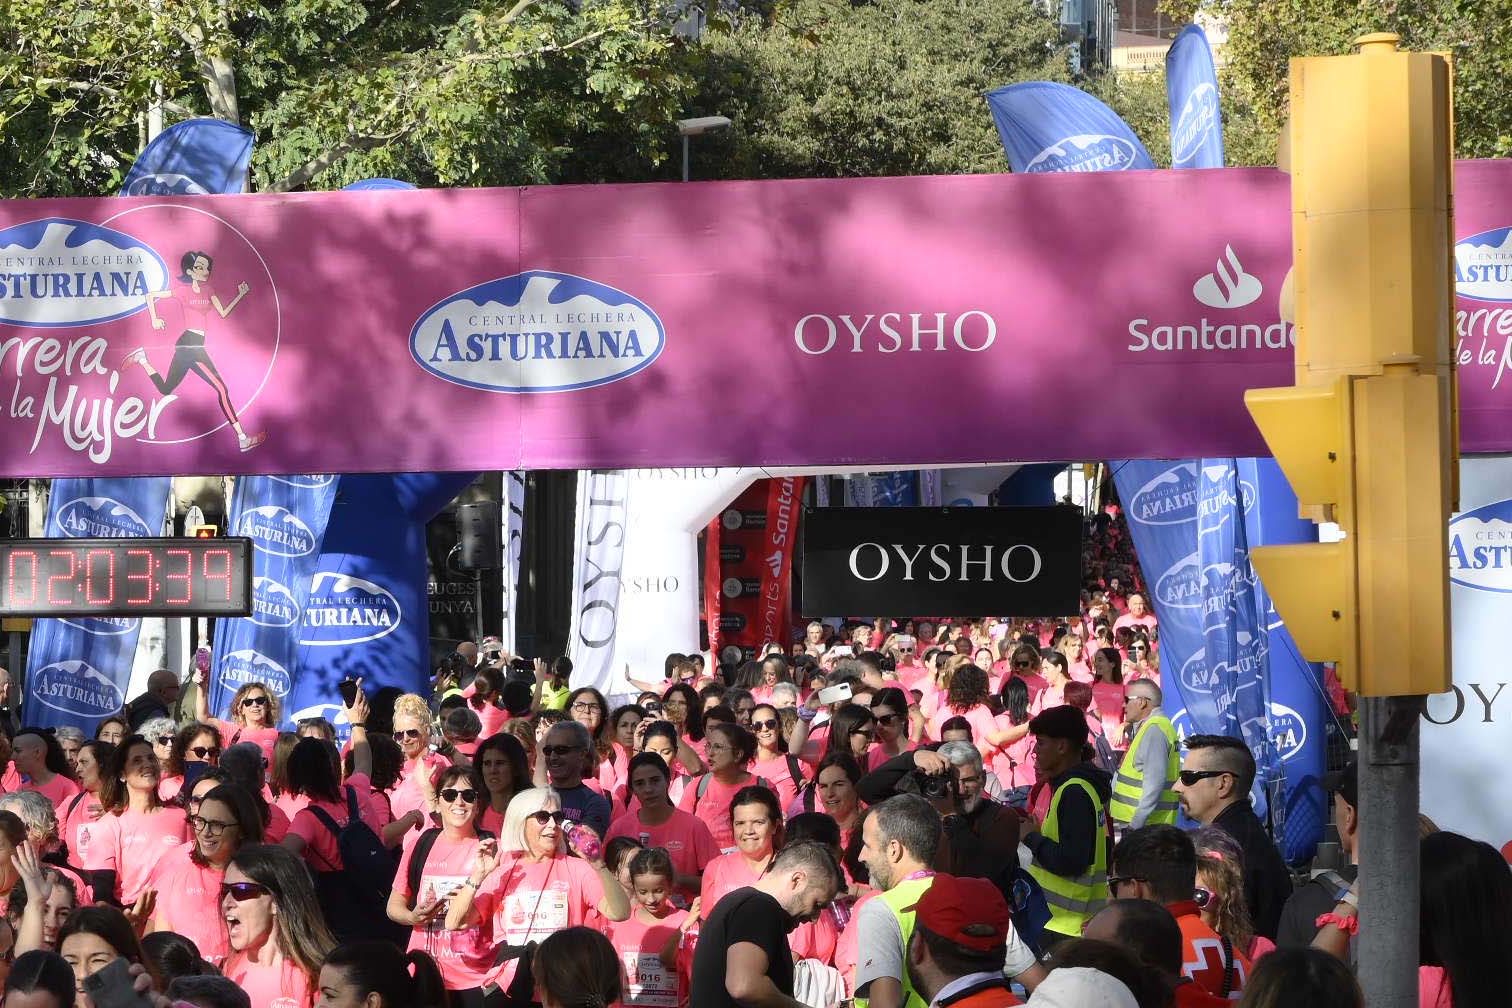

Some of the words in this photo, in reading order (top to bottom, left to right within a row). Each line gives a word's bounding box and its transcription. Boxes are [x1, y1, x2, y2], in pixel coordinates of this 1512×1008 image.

[72, 254, 144, 266] LECHERA
[1454, 254, 1512, 283] ASTU
[1469, 252, 1512, 261] CENTRA
[468, 313, 546, 327] CENTRAL
[554, 312, 637, 325] LECHERA
[793, 310, 998, 355] OYSHO
[1456, 307, 1512, 337] arre
[429, 318, 644, 363] ASTURIANA
[1478, 337, 1496, 365] la
[9, 379, 34, 419] la
[29, 369, 178, 464] Mujer
[580, 470, 625, 648] OYSH
[849, 543, 1042, 583] OYSHO
[8, 549, 232, 604] 02:03:39
[621, 575, 679, 594] YSHO
[310, 597, 334, 605] TRAL
[338, 596, 388, 605] LECHERA
[303, 607, 392, 627] TURIANA
[37, 674, 116, 711] ASTURIANA
[1420, 682, 1508, 726] OY
